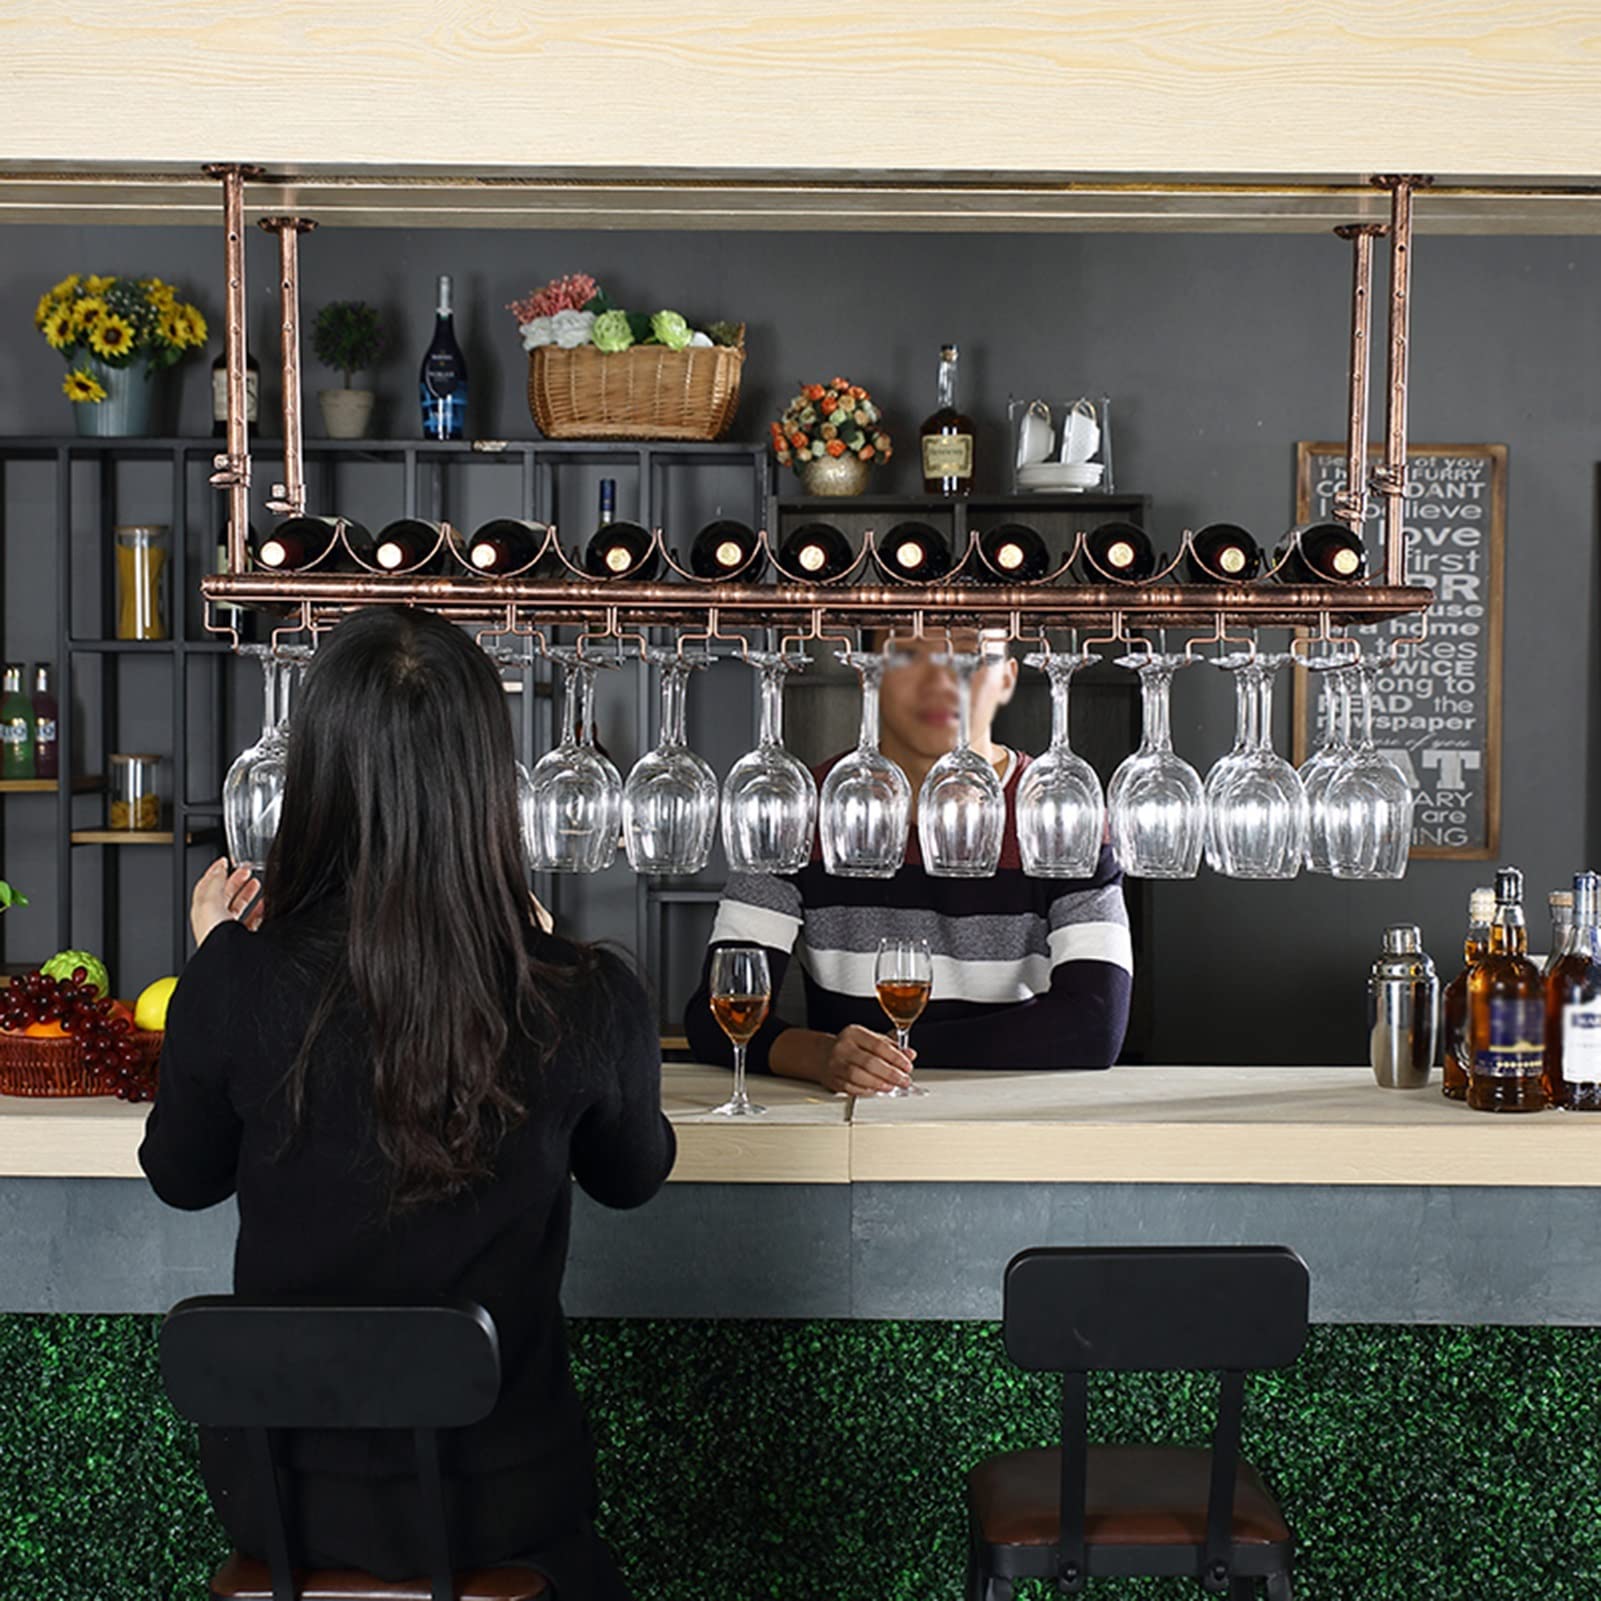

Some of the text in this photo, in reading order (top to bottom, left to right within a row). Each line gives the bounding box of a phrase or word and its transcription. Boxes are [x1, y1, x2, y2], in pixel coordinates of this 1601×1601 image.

[1414, 457, 1485, 469] of you
[1411, 468, 1481, 481] FURRY
[1390, 660, 1475, 677] WICE
[1445, 675, 1476, 694] to
[1434, 696, 1474, 713] the
[1421, 811, 1467, 824] are
